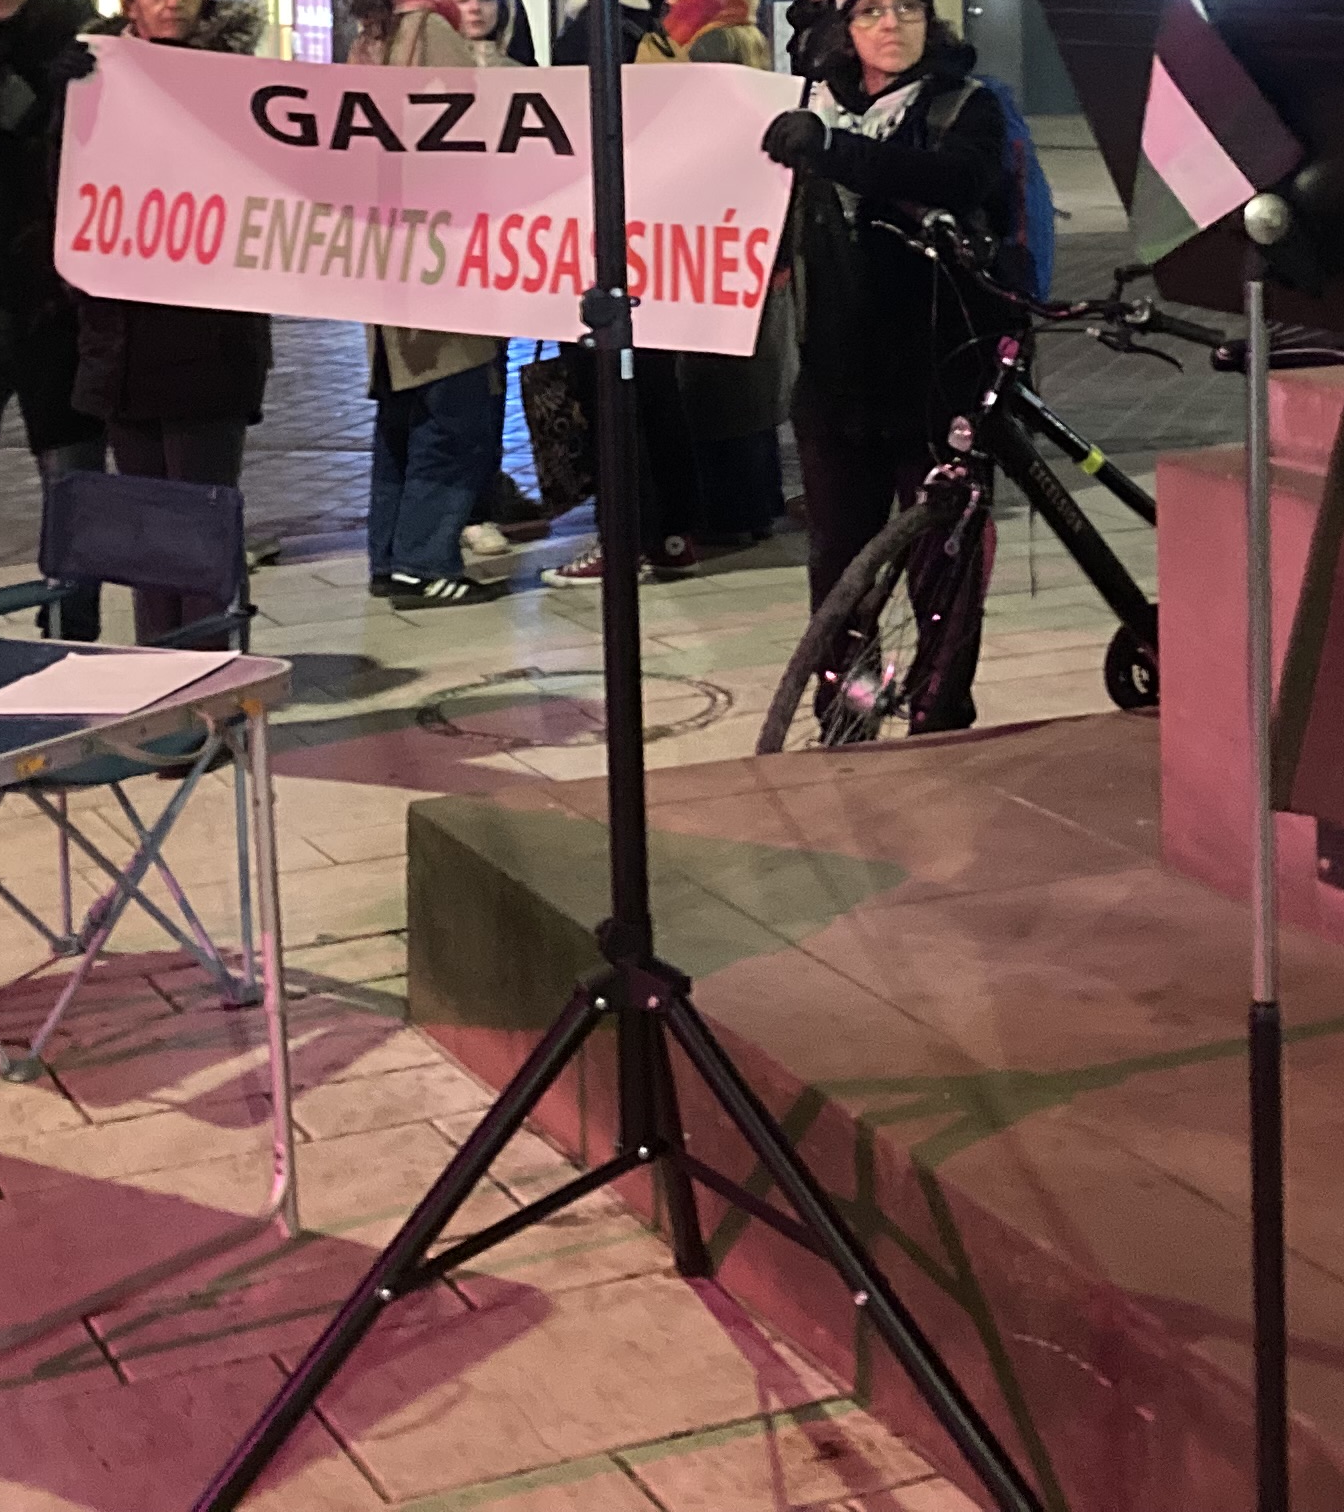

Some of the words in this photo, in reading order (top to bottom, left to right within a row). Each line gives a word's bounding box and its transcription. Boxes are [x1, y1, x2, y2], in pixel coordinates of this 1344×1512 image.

[250, 85, 575, 156] GAZA
[71, 183, 227, 265] 20.000
[233, 195, 452, 285] ENFANTS
[456, 207, 770, 309] ASSASINÉS
